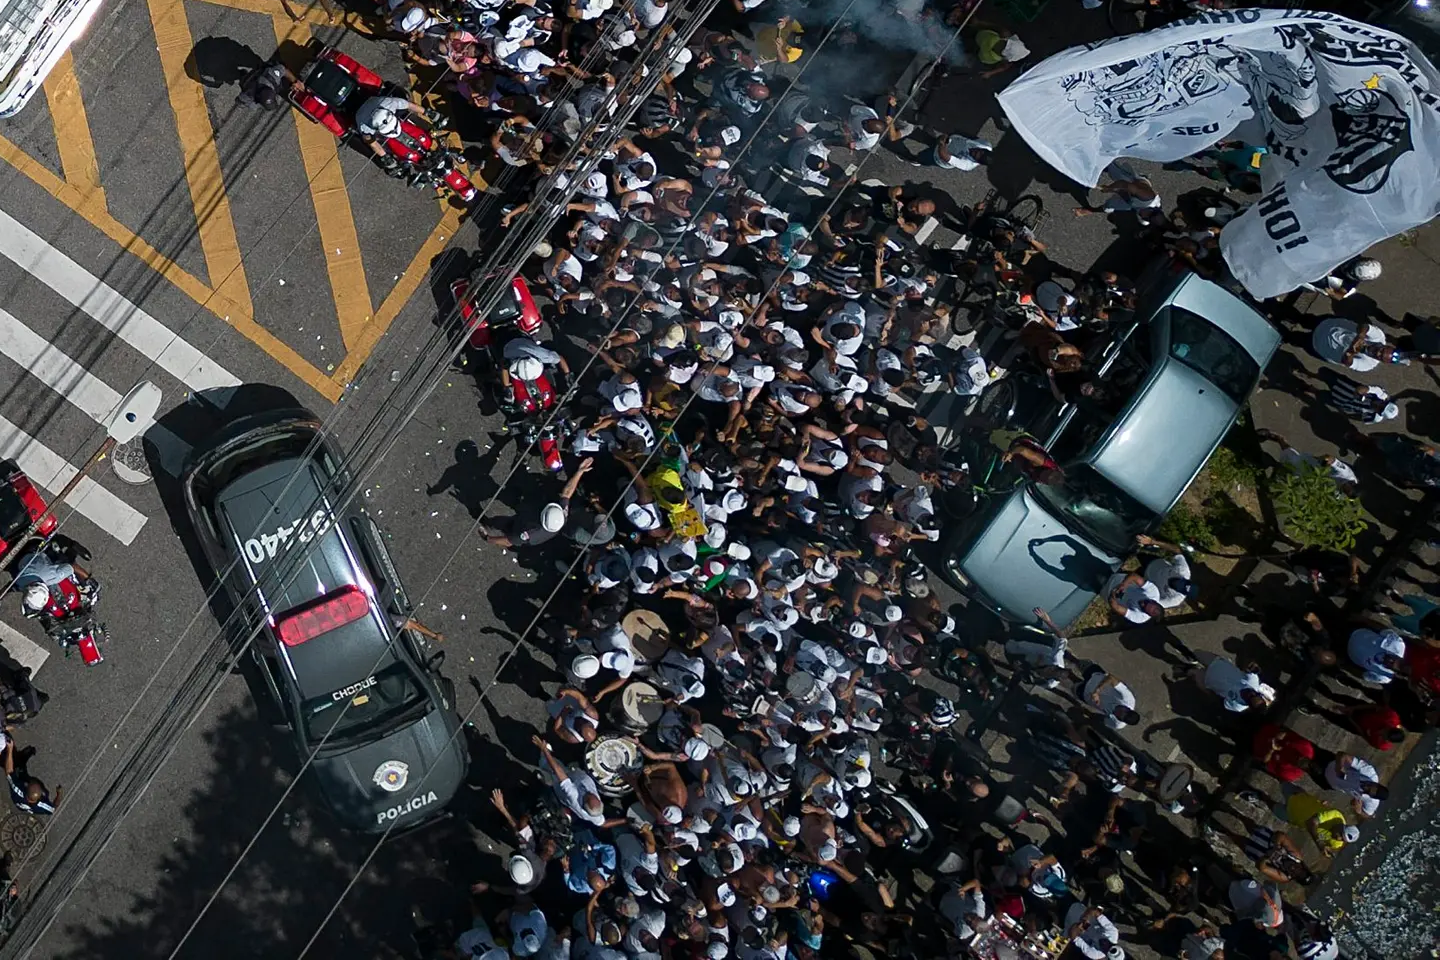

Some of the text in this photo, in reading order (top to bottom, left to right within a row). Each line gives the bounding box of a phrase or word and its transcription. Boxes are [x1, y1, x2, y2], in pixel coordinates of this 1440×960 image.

[1172, 123, 1220, 136] SEU
[1258, 182, 1309, 254] HO!
[377, 791, 438, 824] POLÍCIA
